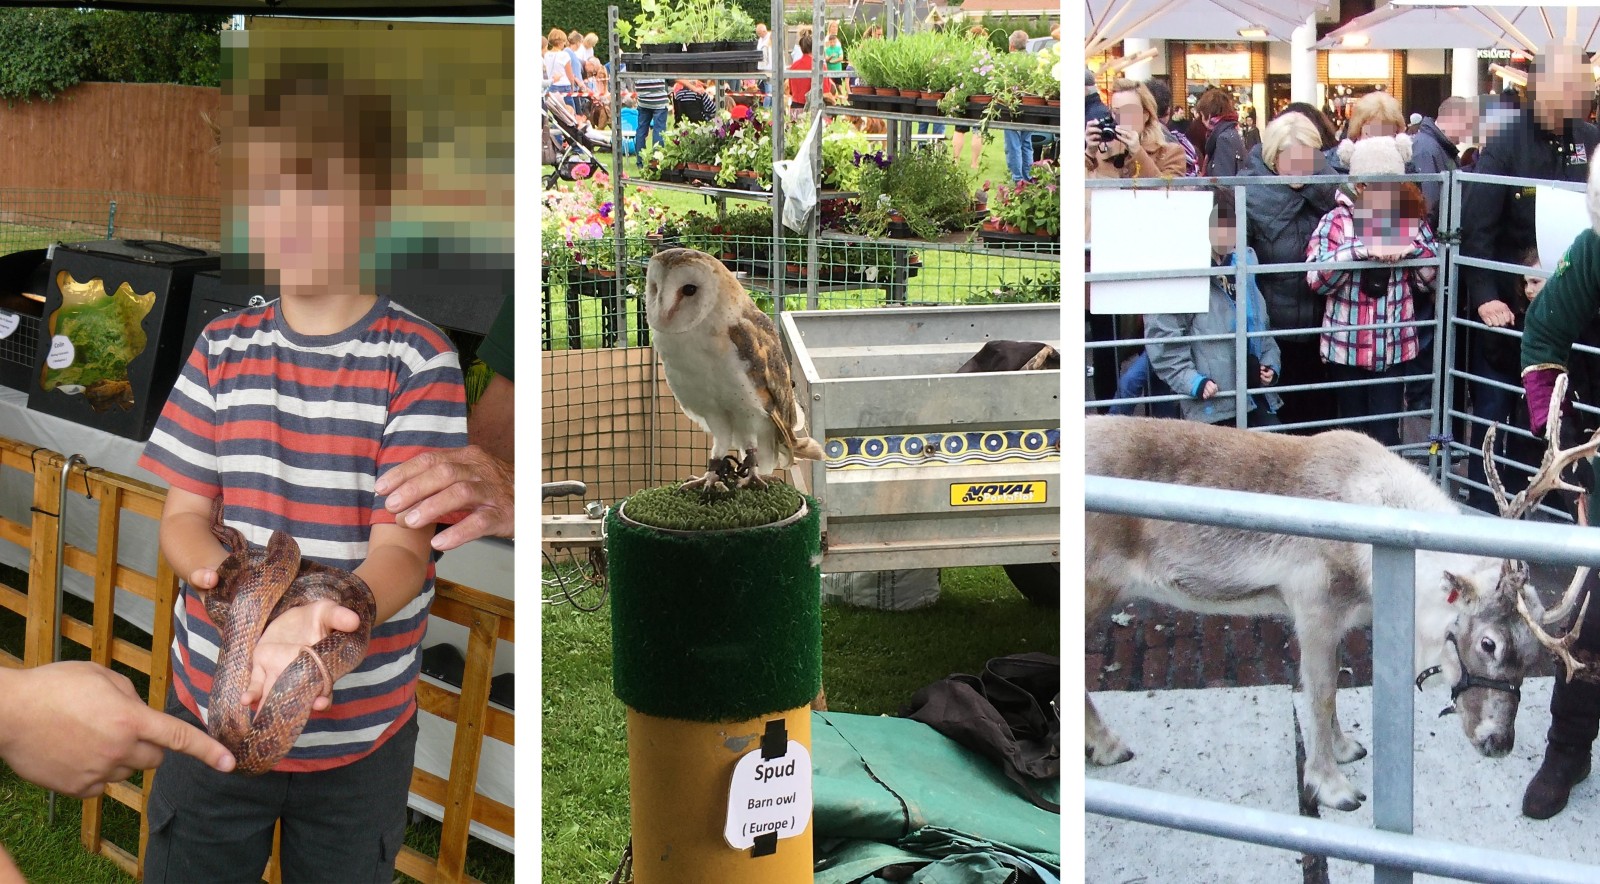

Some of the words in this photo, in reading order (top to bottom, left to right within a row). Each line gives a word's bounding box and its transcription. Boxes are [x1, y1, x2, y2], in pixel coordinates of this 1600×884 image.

[967, 484, 1034, 496] NOVAL
[754, 759, 795, 783] Spud
[748, 798, 773, 809] Barn
[776, 792, 796, 806] owl
[749, 819, 788, 834] Europe
